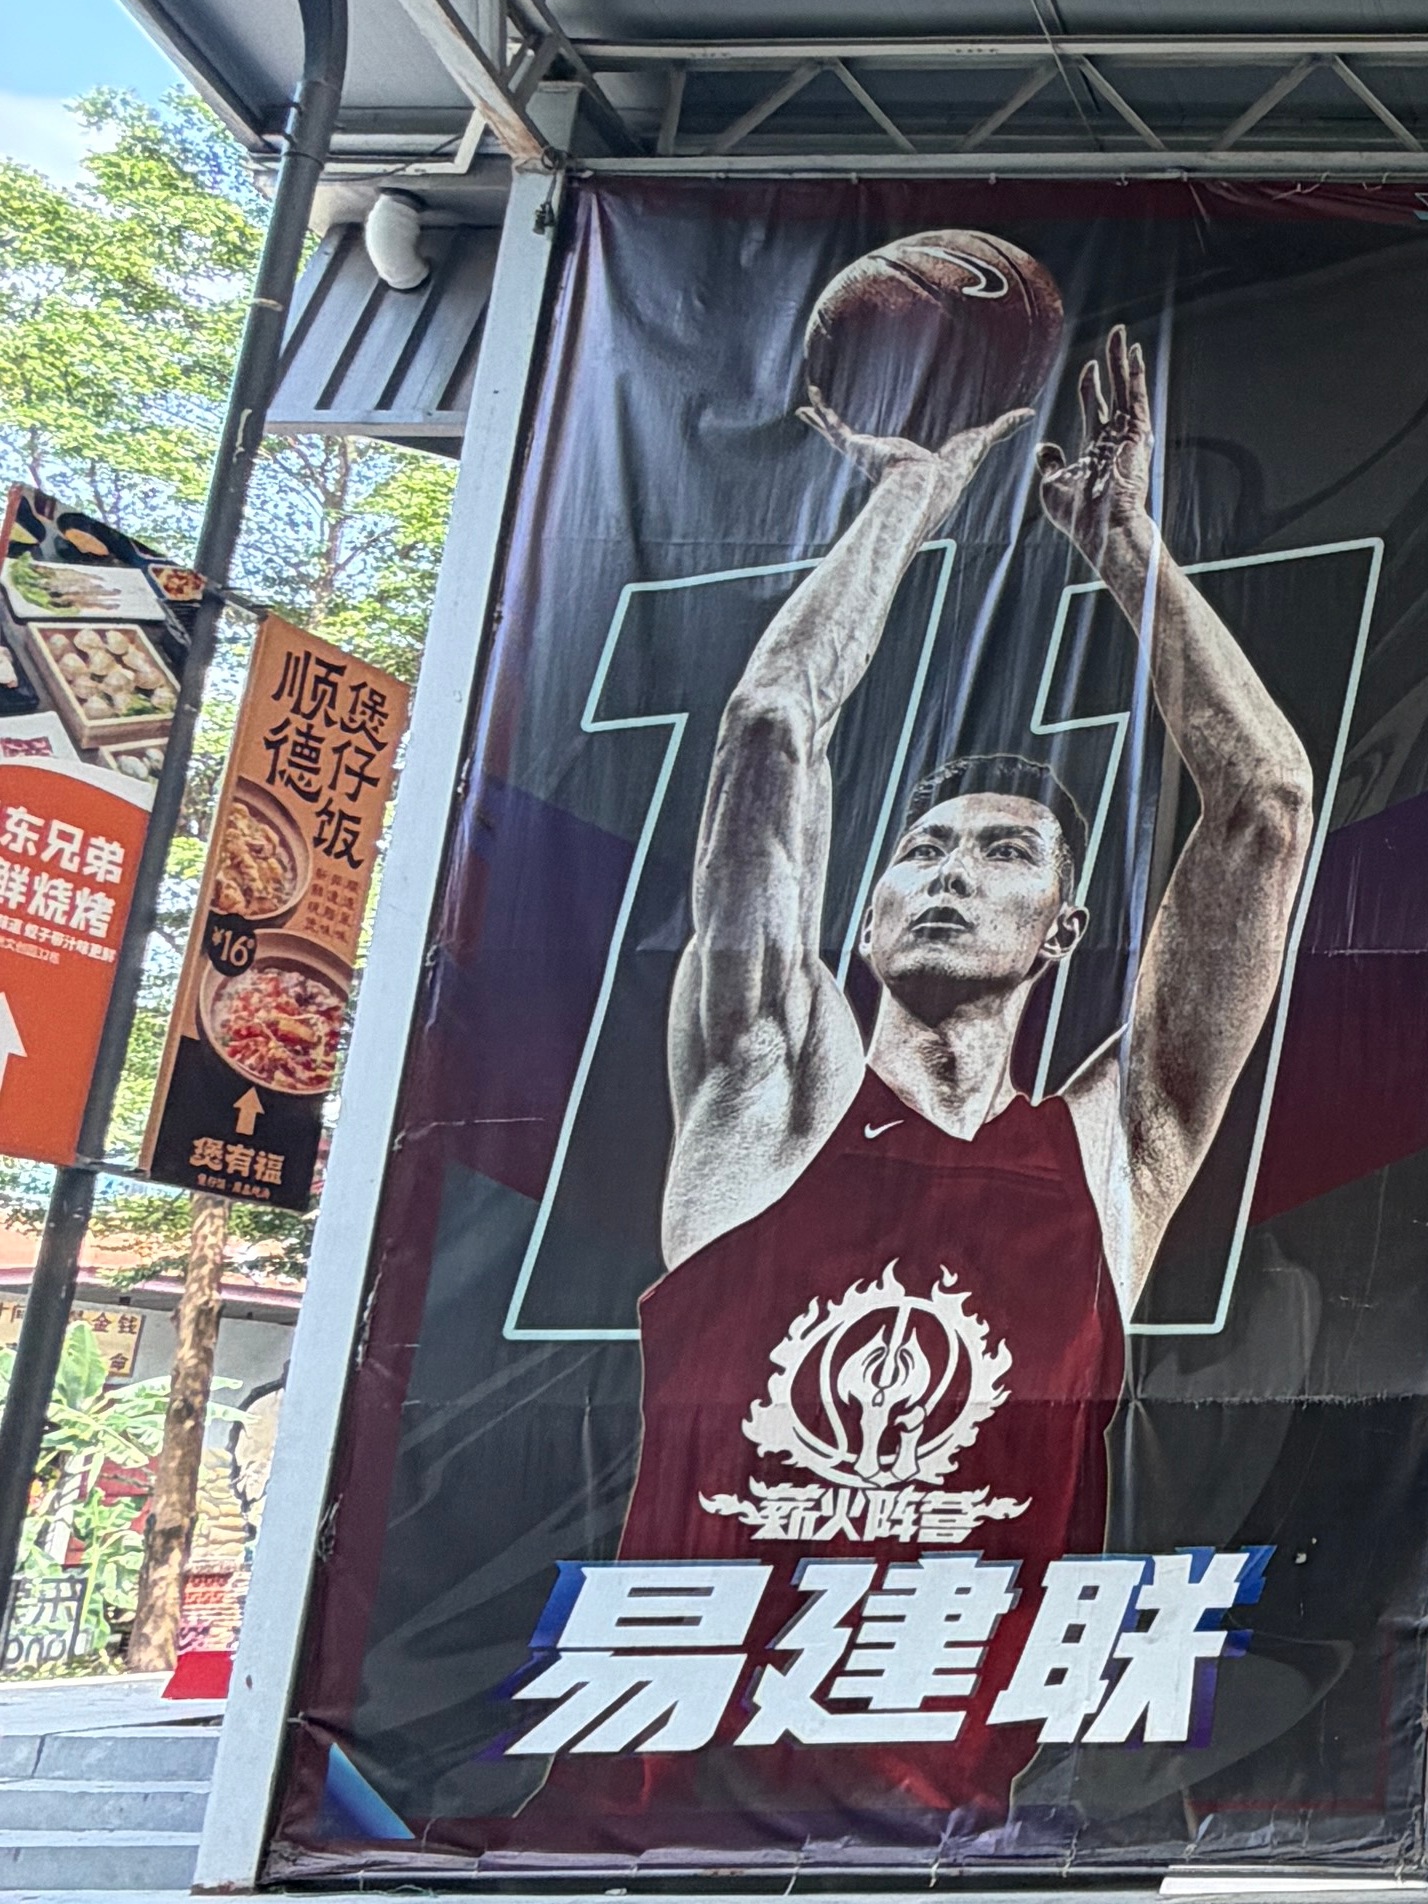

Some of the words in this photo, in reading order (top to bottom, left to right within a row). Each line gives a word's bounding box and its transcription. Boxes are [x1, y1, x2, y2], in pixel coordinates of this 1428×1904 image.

[264, 650, 348, 804] 顺德
[313, 680, 390, 870] 煲仔饭
[189, 1137, 285, 1185] 煲有福
[738, 1476, 995, 1545] 薪火阵营
[505, 1550, 1250, 1754] 易建联
